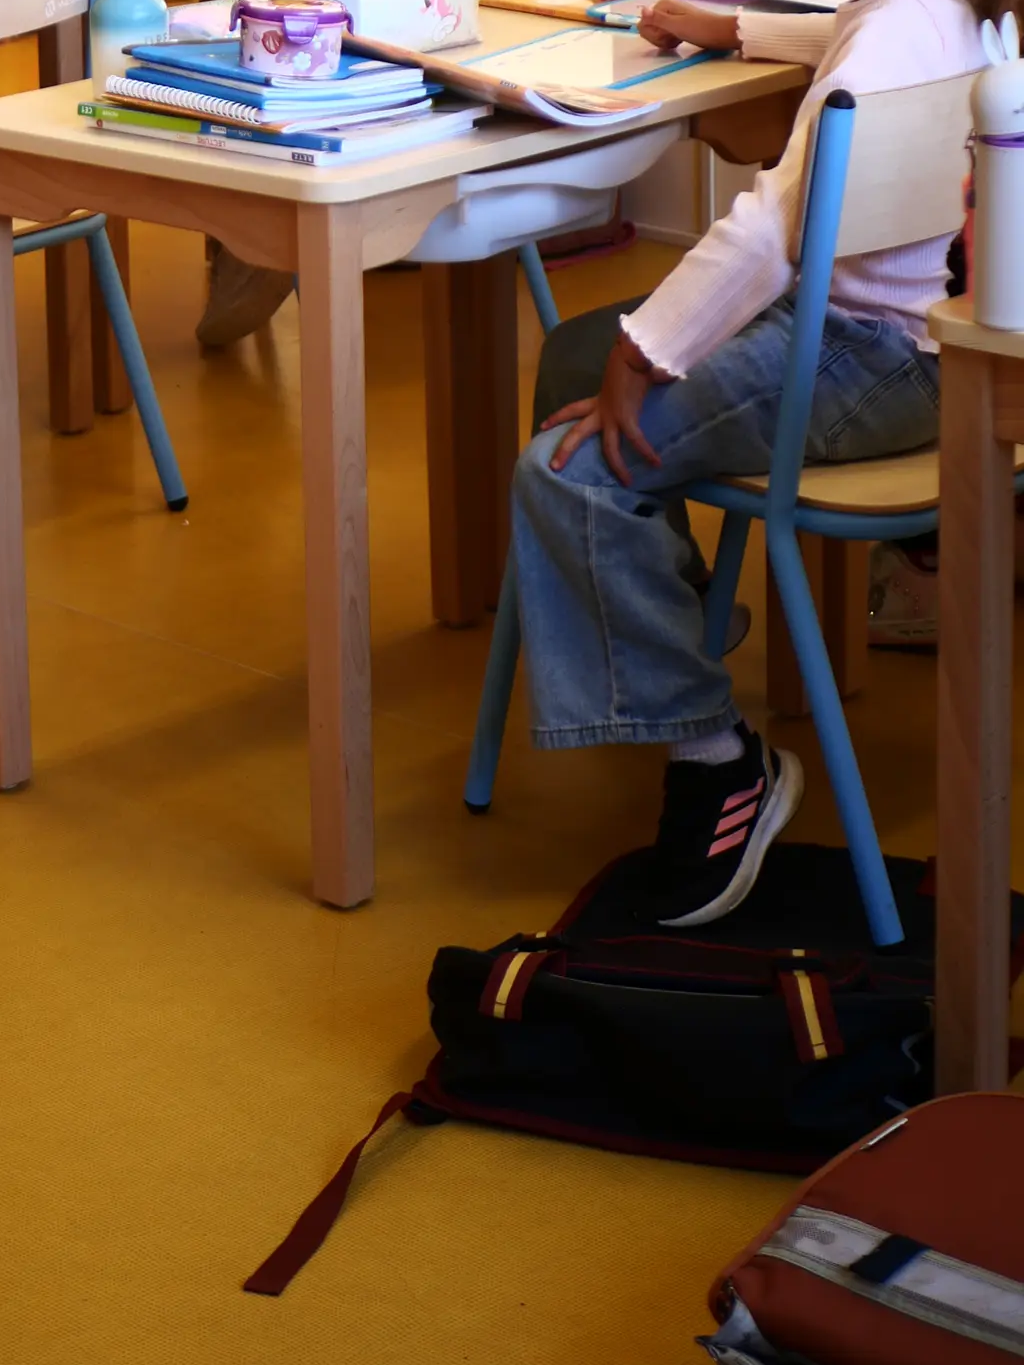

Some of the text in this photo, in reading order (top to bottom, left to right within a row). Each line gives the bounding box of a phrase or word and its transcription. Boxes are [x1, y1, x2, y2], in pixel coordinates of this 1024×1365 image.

[80, 105, 94, 116] CE1
[196, 135, 227, 149] LECTURE
[292, 152, 314, 164] RETZ
